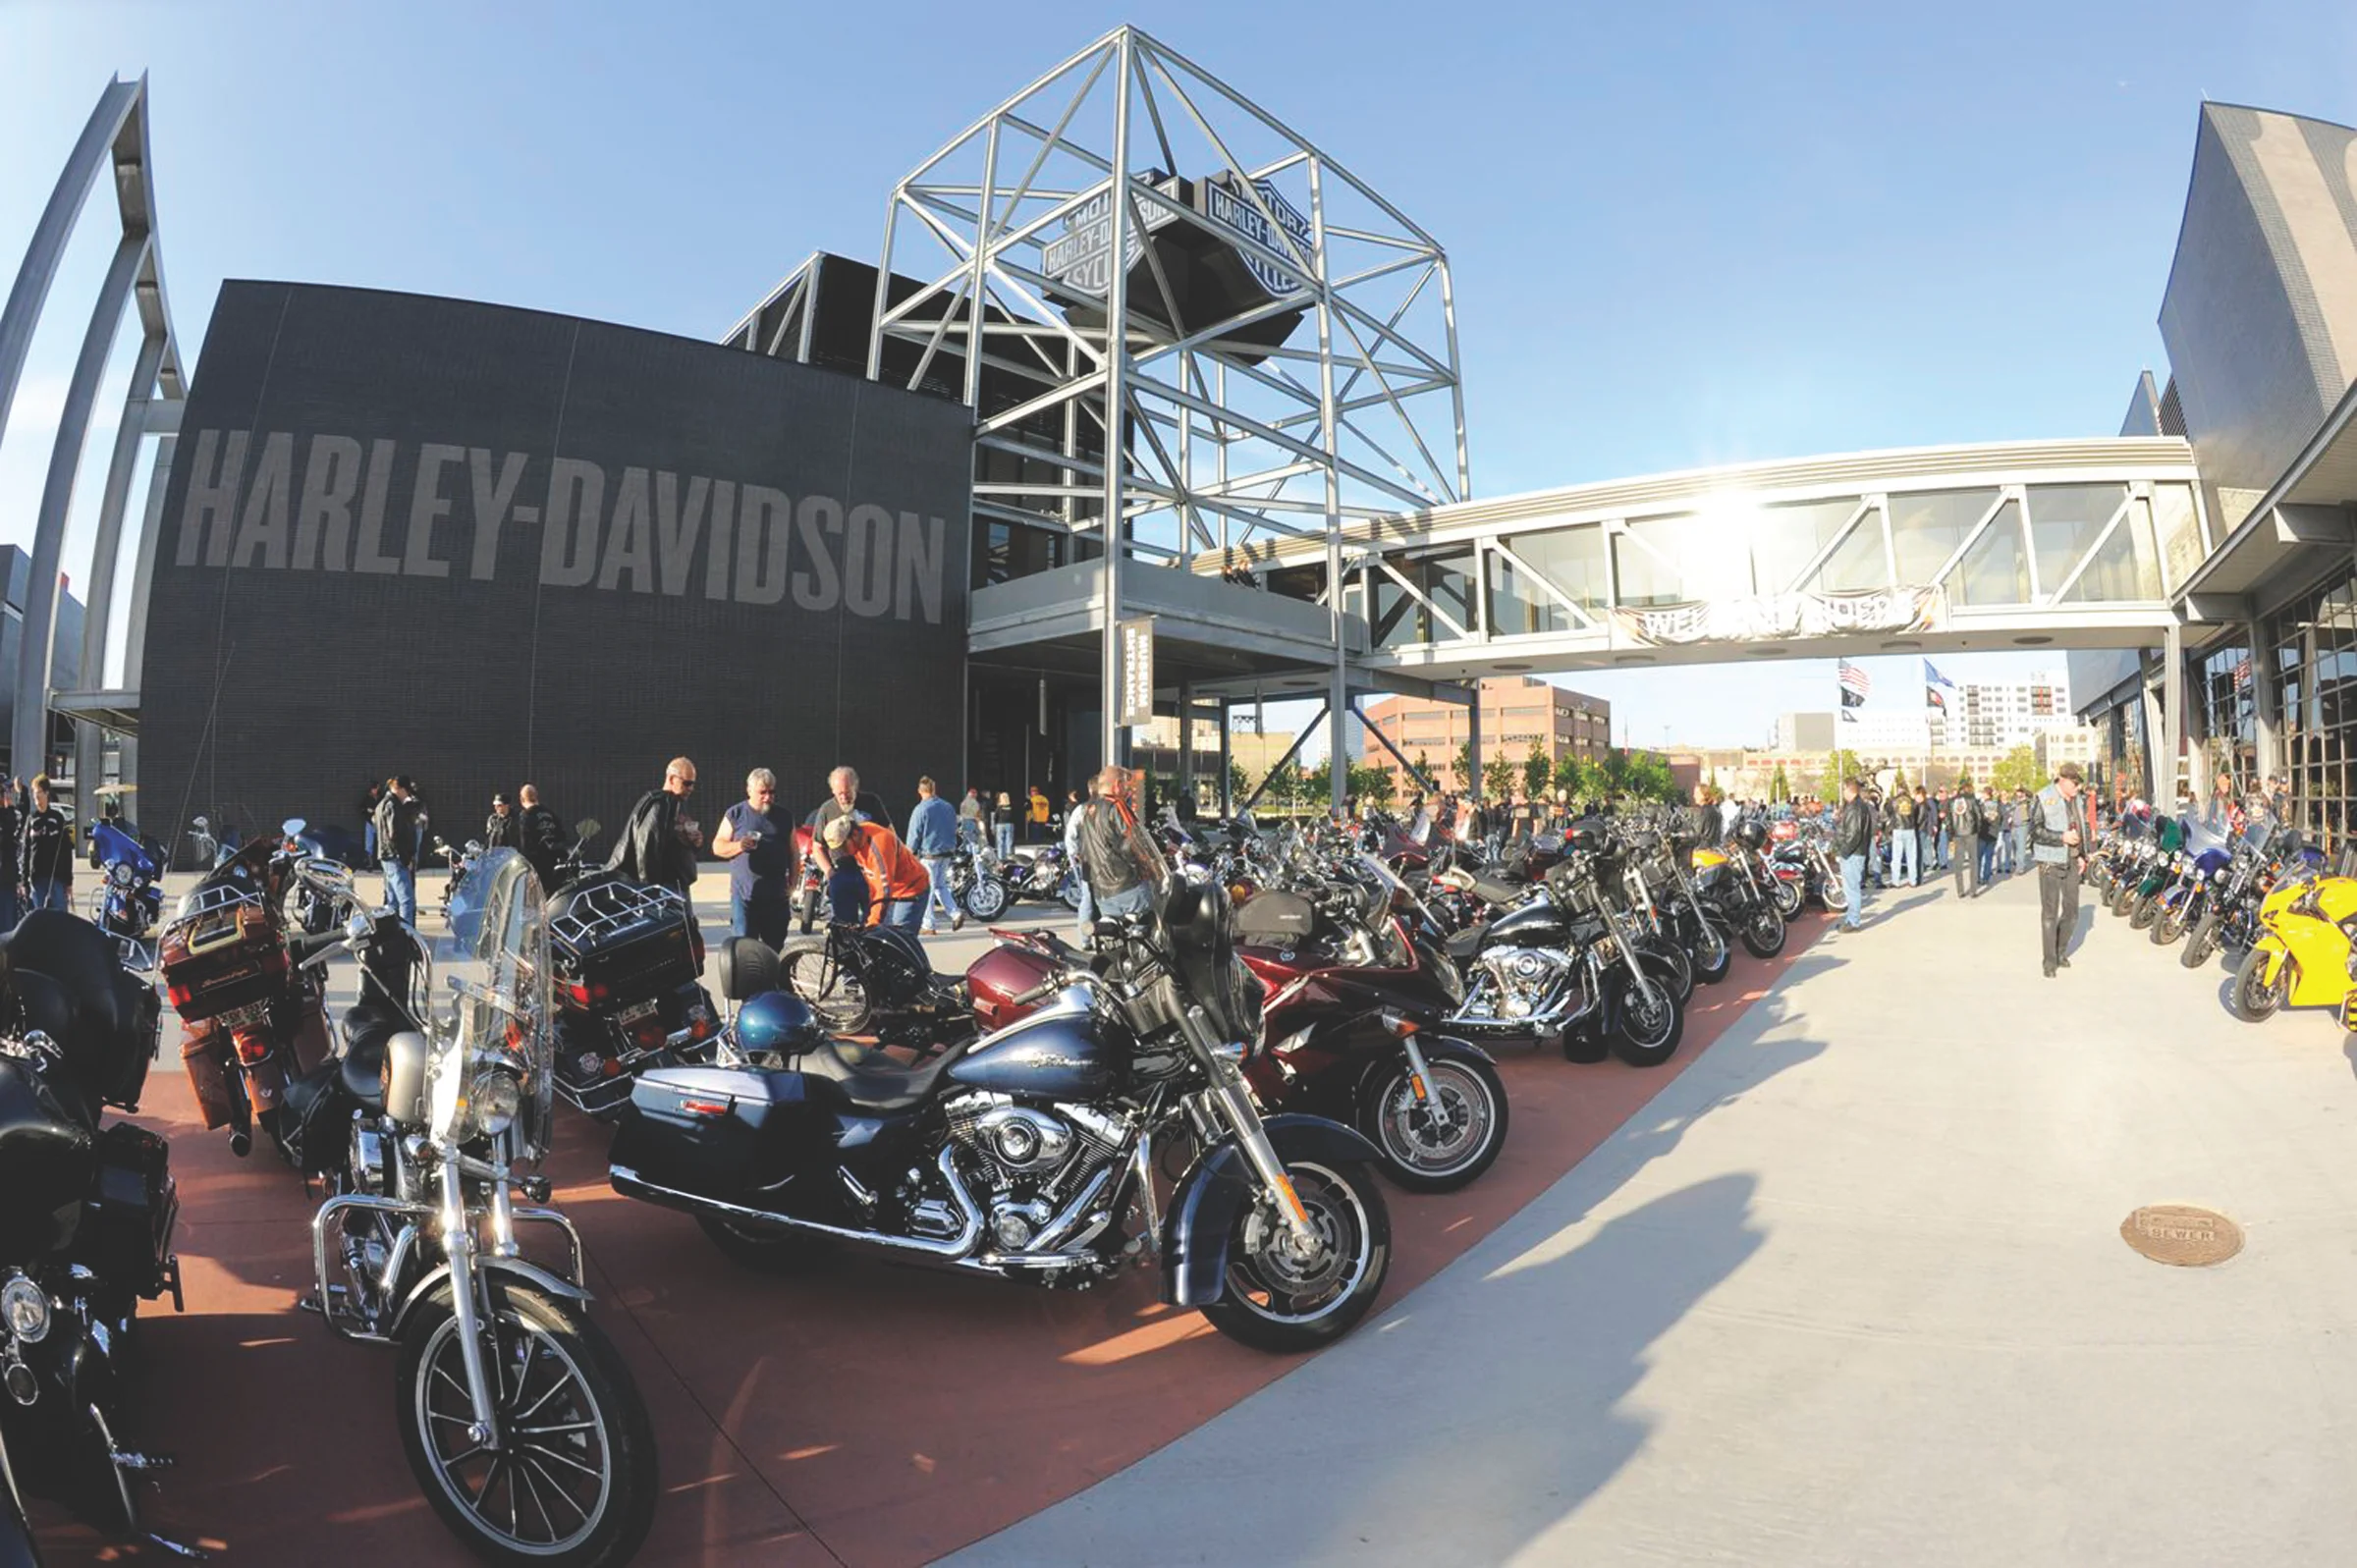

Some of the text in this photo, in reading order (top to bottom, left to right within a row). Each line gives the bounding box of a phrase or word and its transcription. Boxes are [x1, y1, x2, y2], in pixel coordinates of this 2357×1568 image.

[1047, 189, 1172, 272] HARLEY-DSO
[1215, 192, 1314, 267] HARLEY-DASO
[1241, 188, 1298, 232] MTOR
[175, 429, 946, 625] HARLEY-DAVIDSON
[2151, 1228, 2215, 1241] SEWER
